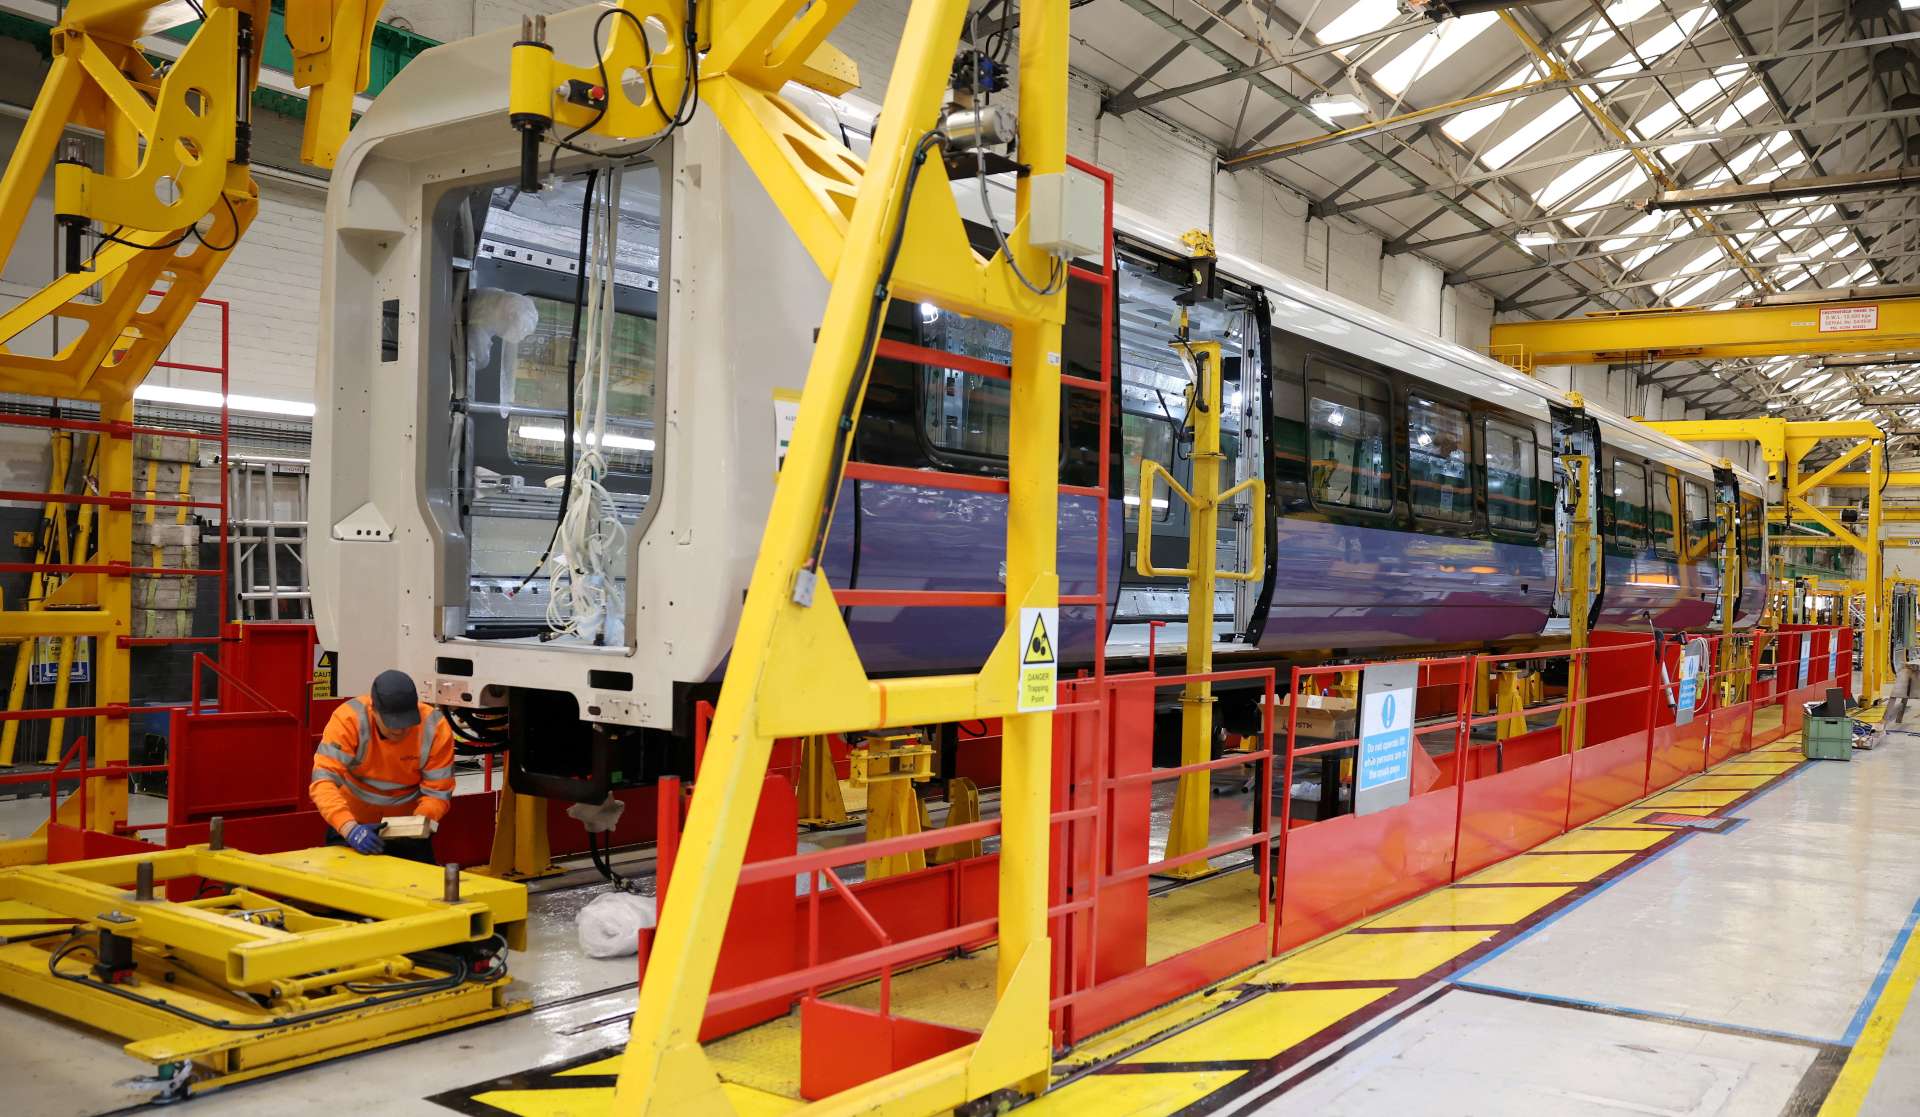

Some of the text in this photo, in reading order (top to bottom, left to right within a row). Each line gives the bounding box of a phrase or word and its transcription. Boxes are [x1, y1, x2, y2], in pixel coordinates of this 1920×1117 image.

[1028, 672, 1048, 680] DANGER
[1027, 684, 1049, 693] Trapping
[1031, 695, 1045, 703] Point
[1368, 743, 1375, 753] Do
[1364, 757, 1377, 768] while
[1376, 753, 1393, 768] persons
